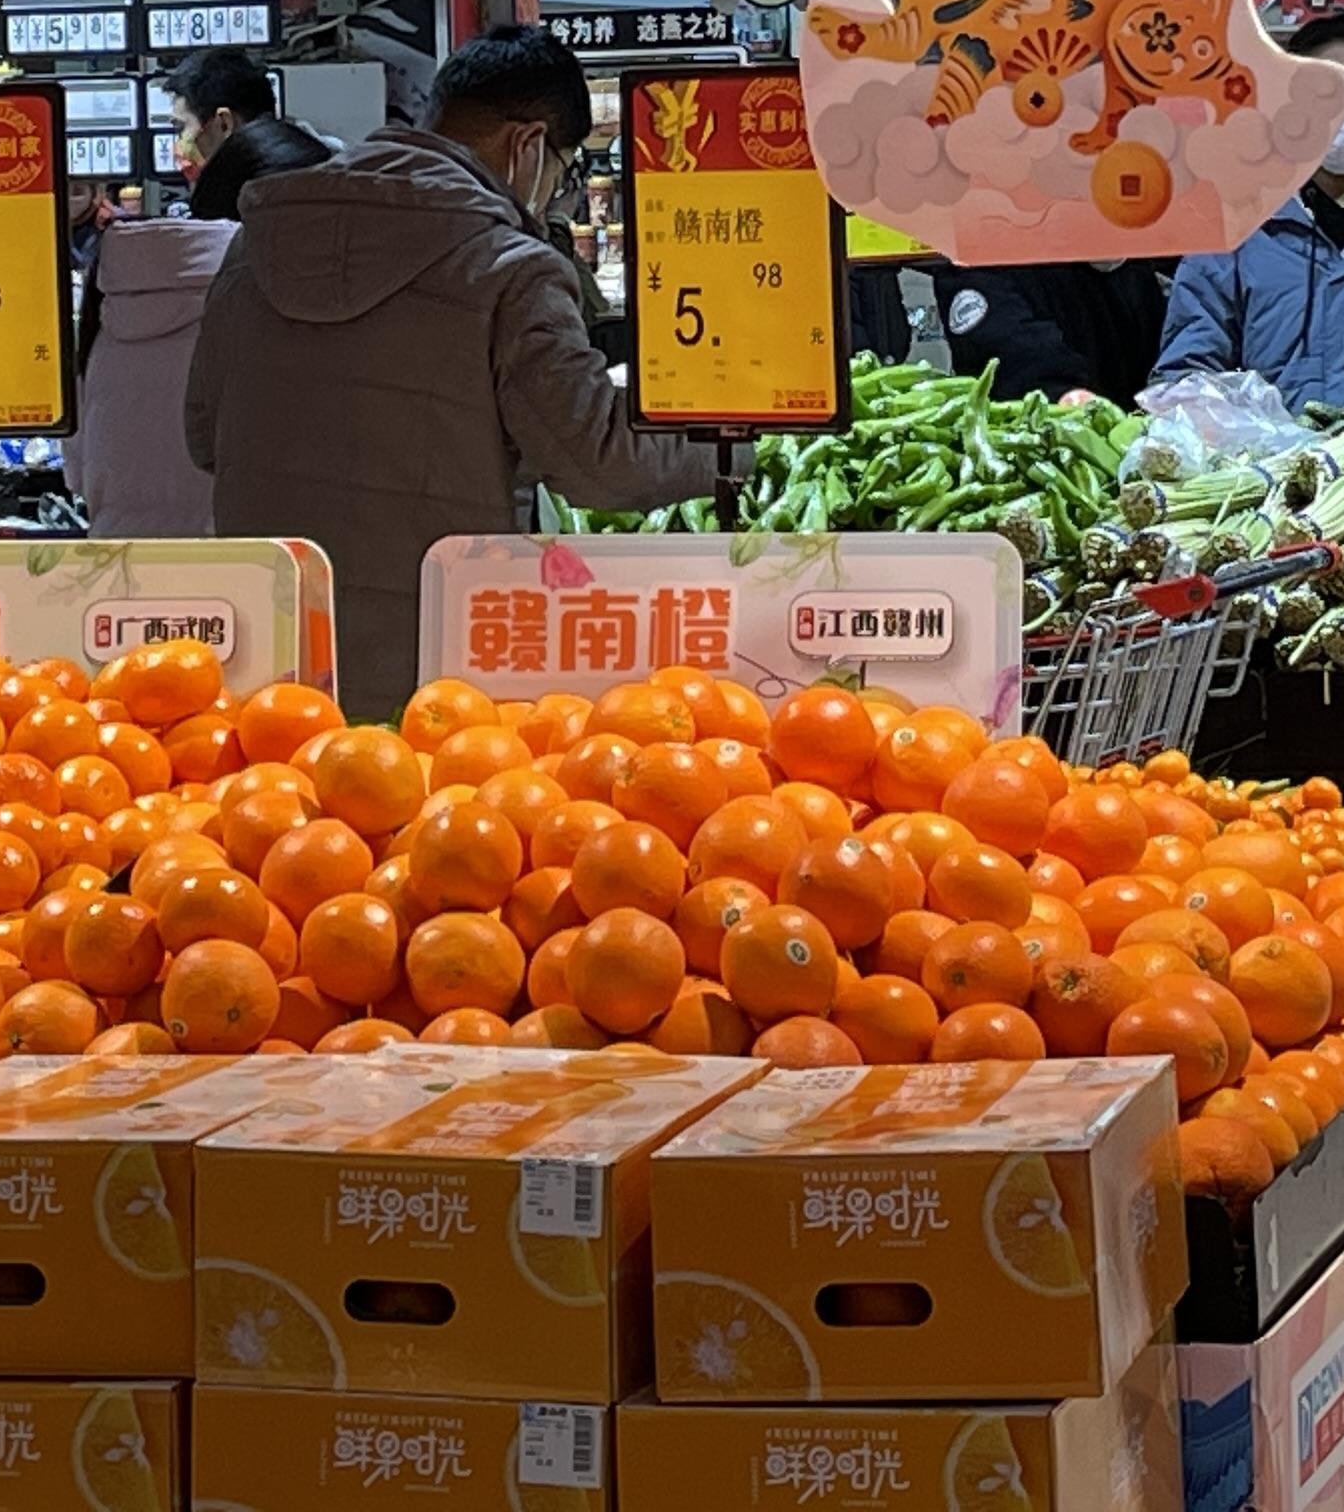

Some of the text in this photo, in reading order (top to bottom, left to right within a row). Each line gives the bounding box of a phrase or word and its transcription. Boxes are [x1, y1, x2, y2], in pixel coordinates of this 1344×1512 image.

[739, 107, 808, 134] 实惠到
[674, 207, 765, 246] 赣南橙
[647, 261, 662, 292] ¥
[752, 263, 783, 288] 98
[810, 327, 825, 345] 元
[34, 344, 50, 361] 元
[117, 616, 225, 646] 广西武鸣
[469, 588, 732, 673] 赣南橙
[818, 607, 945, 639] 江西赣州
[337, 1183, 478, 1245] 鲜果时光
[803, 1184, 950, 1247] 鲜果时光
[333, 1425, 472, 1487] 鲜果时光
[765, 1440, 910, 1504] 鲜果时光
